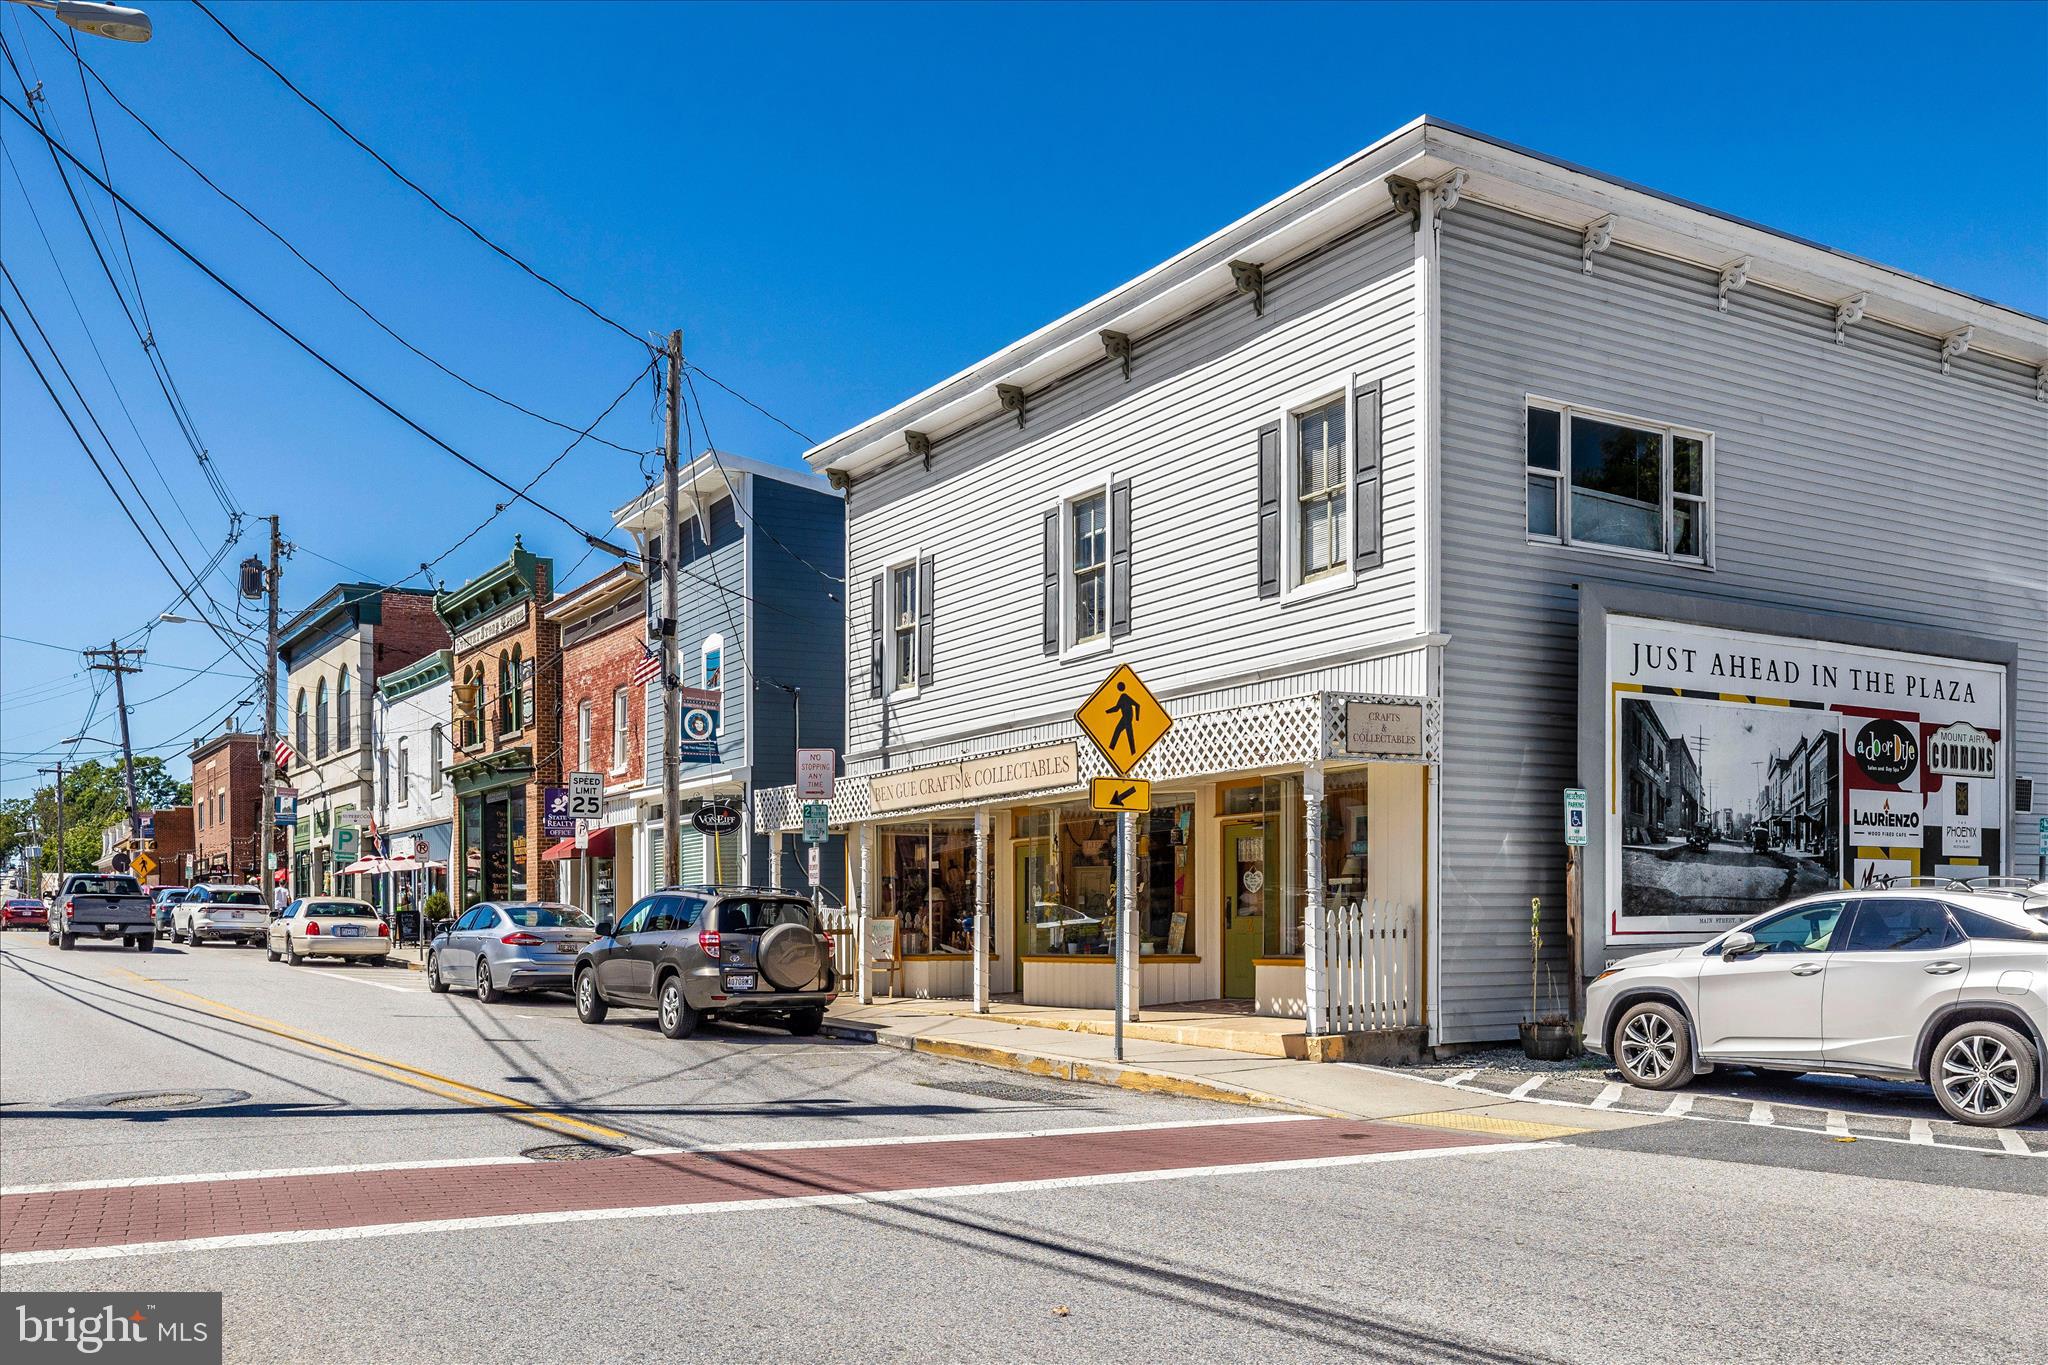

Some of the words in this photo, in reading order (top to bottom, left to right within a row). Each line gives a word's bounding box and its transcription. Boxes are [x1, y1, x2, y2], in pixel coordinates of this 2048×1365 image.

[1630, 643, 1697, 676] JUST
[1710, 653, 1800, 687] AHEAD
[1811, 664, 1838, 688] IN
[1849, 669, 1896, 694] THE
[1906, 675, 1976, 703] PLAZA
[1368, 712, 1400, 721] CRAFTS
[1381, 723, 1387, 732] &
[1352, 733, 1416, 744] COLLECTABLES
[1940, 732, 1967, 742] MOUNT
[1968, 735, 1986, 744] AIRY
[1893, 734, 1915, 770] Dye
[1932, 742, 1993, 773] COMMONS
[801, 763, 830, 771] STOPPING
[875, 784, 894, 802] BEN
[896, 780, 918, 799] GUE
[919, 772, 961, 796] CRAFTS
[963, 771, 972, 788] &
[974, 755, 1070, 786] COLLECTABLES
[572, 797, 599, 813] 25
[804, 806, 811, 818] 2
[1946, 826, 1977, 837] PHOENIX
[339, 831, 353, 850] P
